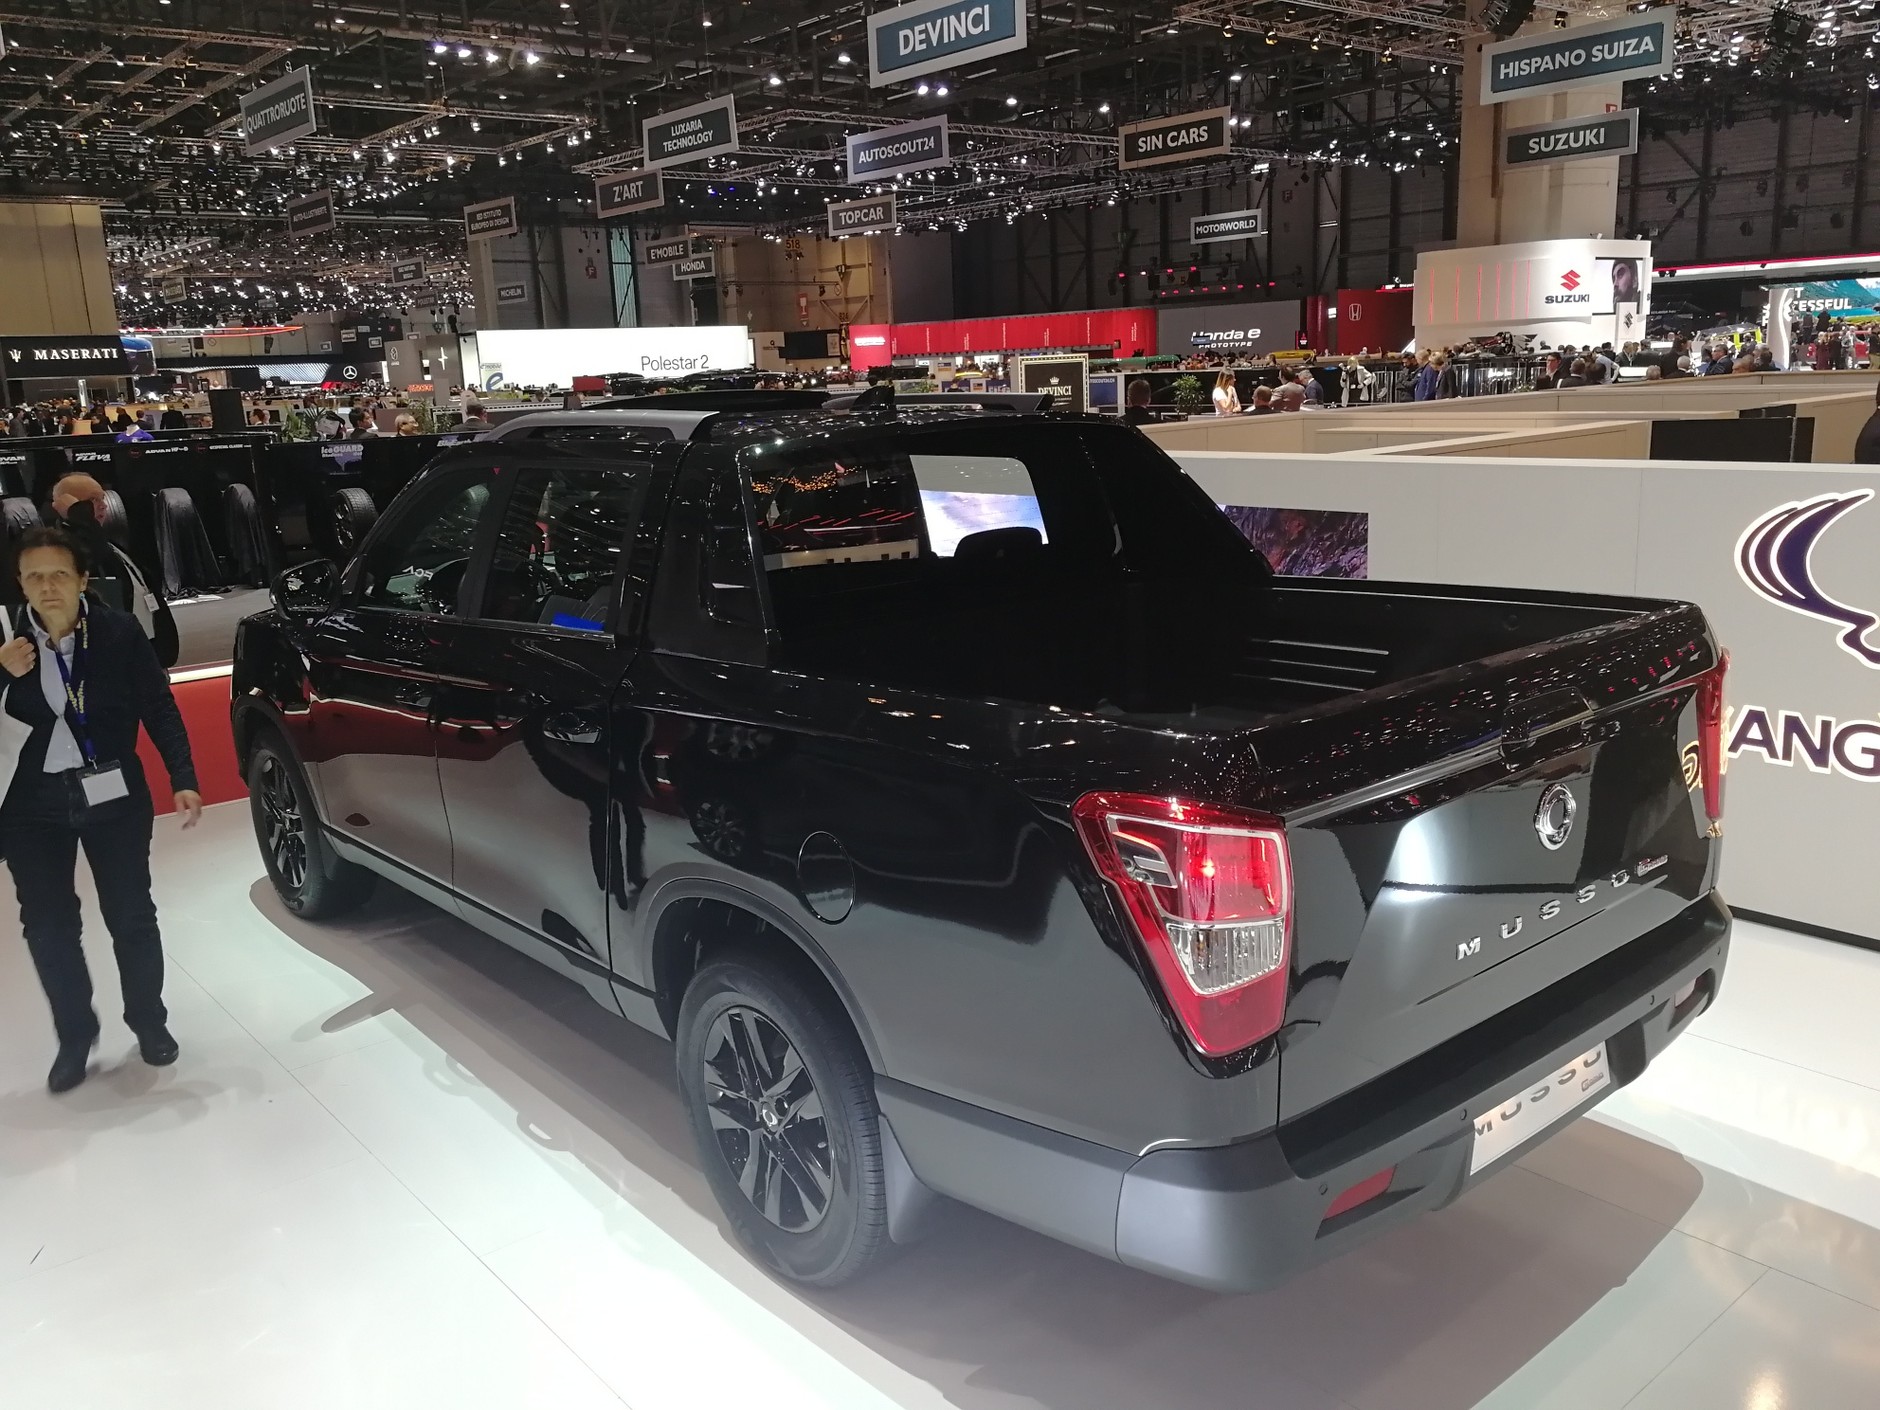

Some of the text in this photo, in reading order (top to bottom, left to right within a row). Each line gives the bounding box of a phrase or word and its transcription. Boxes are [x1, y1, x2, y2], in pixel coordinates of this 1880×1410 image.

[899, 4, 990, 56] DEVINCI
[1500, 35, 1655, 80] HISPANO SUIZA
[247, 93, 306, 134] QUATTRORUOTE
[671, 119, 703, 137] LUXARIA
[663, 130, 714, 152] TECHNOLOGY
[1138, 125, 1208, 152] SIN CARS
[1528, 127, 1605, 154] SUZUKI
[858, 136, 934, 164] AUTOSCOUT24
[613, 181, 643, 202] Z'ART
[839, 207, 884, 225] TOPCAR
[1196, 219, 1256, 235] MOTORWORLD
[650, 244, 684, 260] E'MOBILE
[786, 240, 800, 249] 518
[681, 260, 705, 272] HONDA
[500, 287, 522, 297] MICHELIN
[1545, 294, 1590, 304] SUZUKI
[1247, 328, 1261, 339] e
[33, 348, 119, 360] MASERATI
[641, 354, 709, 371] Polestar 2
[1037, 385, 1072, 396] DEVINCI
[1456, 869, 1630, 951] MUSSO
